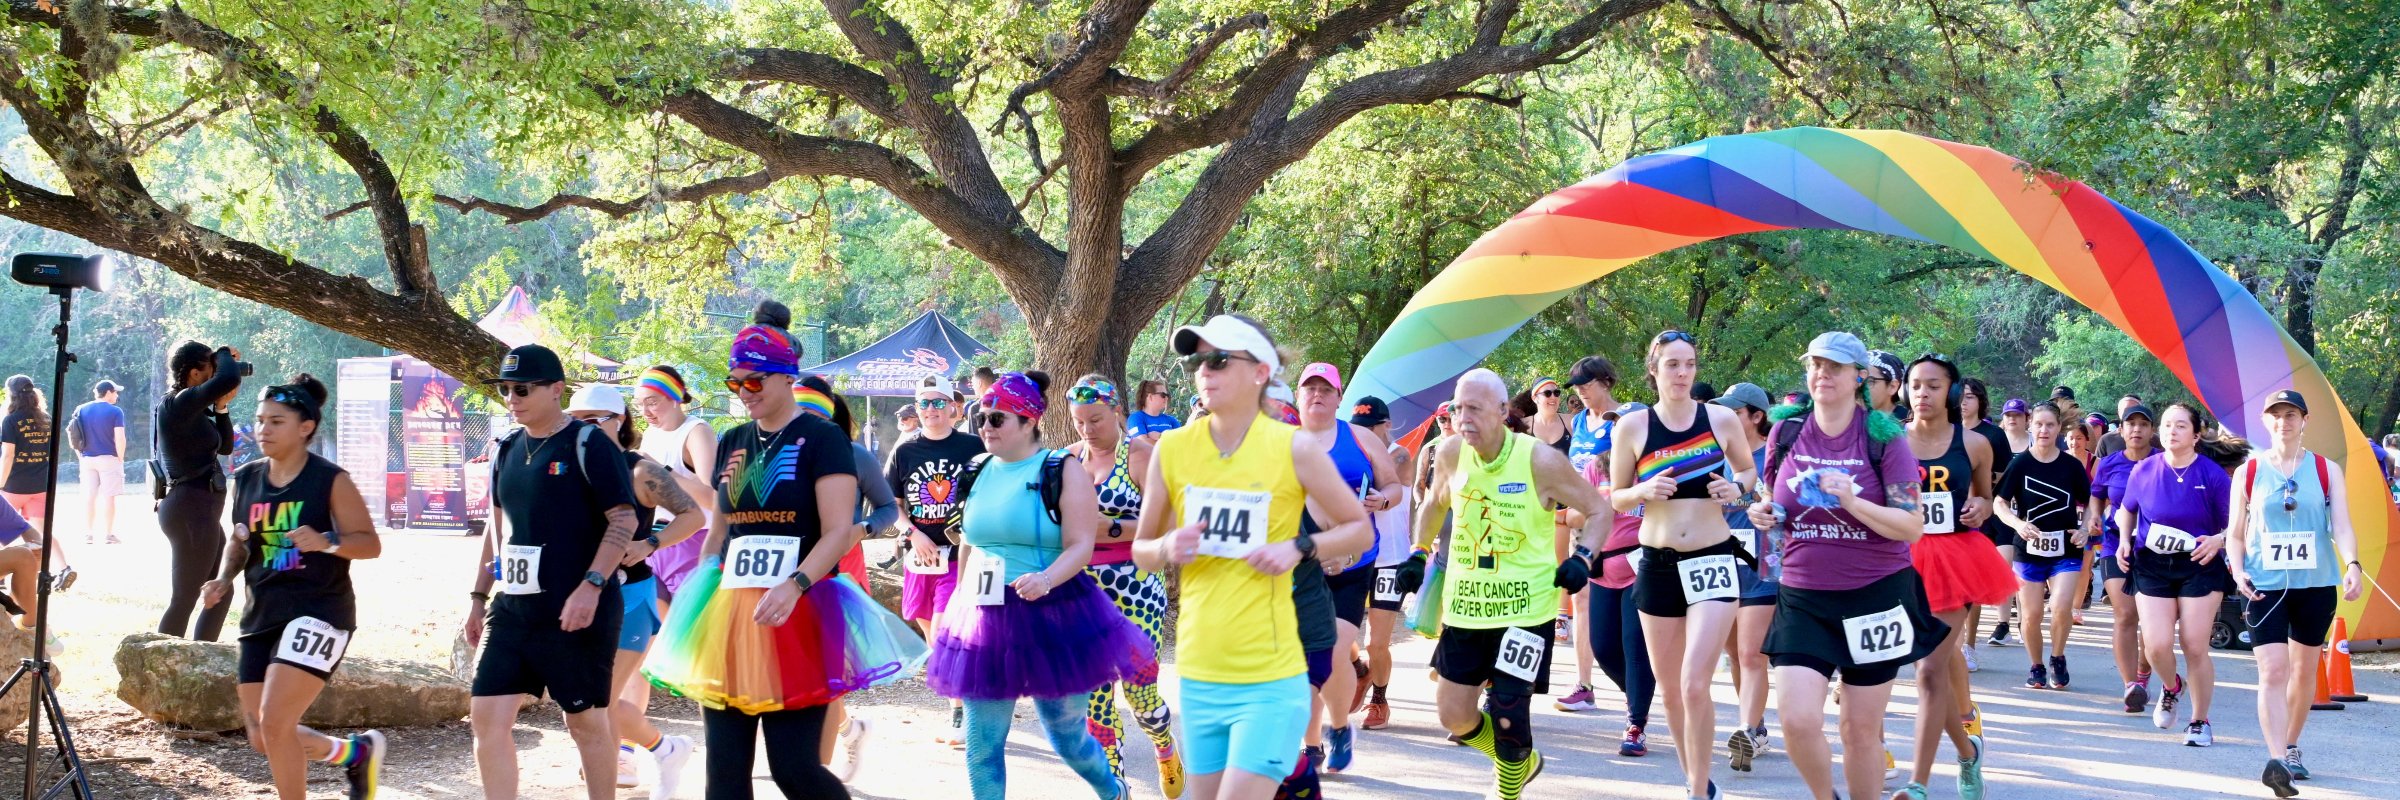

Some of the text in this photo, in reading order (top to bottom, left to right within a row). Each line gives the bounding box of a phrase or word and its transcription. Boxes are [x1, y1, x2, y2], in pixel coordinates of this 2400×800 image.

[1654, 447, 1712, 460] PELOTON
[907, 459, 949, 506] INSPIRE
[1499, 485, 1527, 493] VETERAN
[921, 502, 956, 519] PRID
[1492, 501, 1526, 510] WOODLAWN
[1499, 510, 1515, 518] PARK
[248, 501, 304, 532] PLAY
[1198, 506, 1251, 544] 444
[1791, 529, 1868, 540] WITH AN AXE
[2154, 534, 2186, 552] 474
[2031, 537, 2060, 552] 489
[2270, 543, 2309, 561] 714
[261, 545, 307, 571] PRIDE
[735, 549, 785, 577] 687
[1376, 576, 1401, 595] 67
[1689, 565, 1732, 593] 523
[1458, 580, 1482, 598] BEAT
[1483, 581, 1530, 599] CANCER
[1449, 597, 1531, 618] NEVER GIVE UP!
[291, 627, 337, 661] 574
[1860, 620, 1906, 653] 422
[1503, 639, 1542, 673] 567
